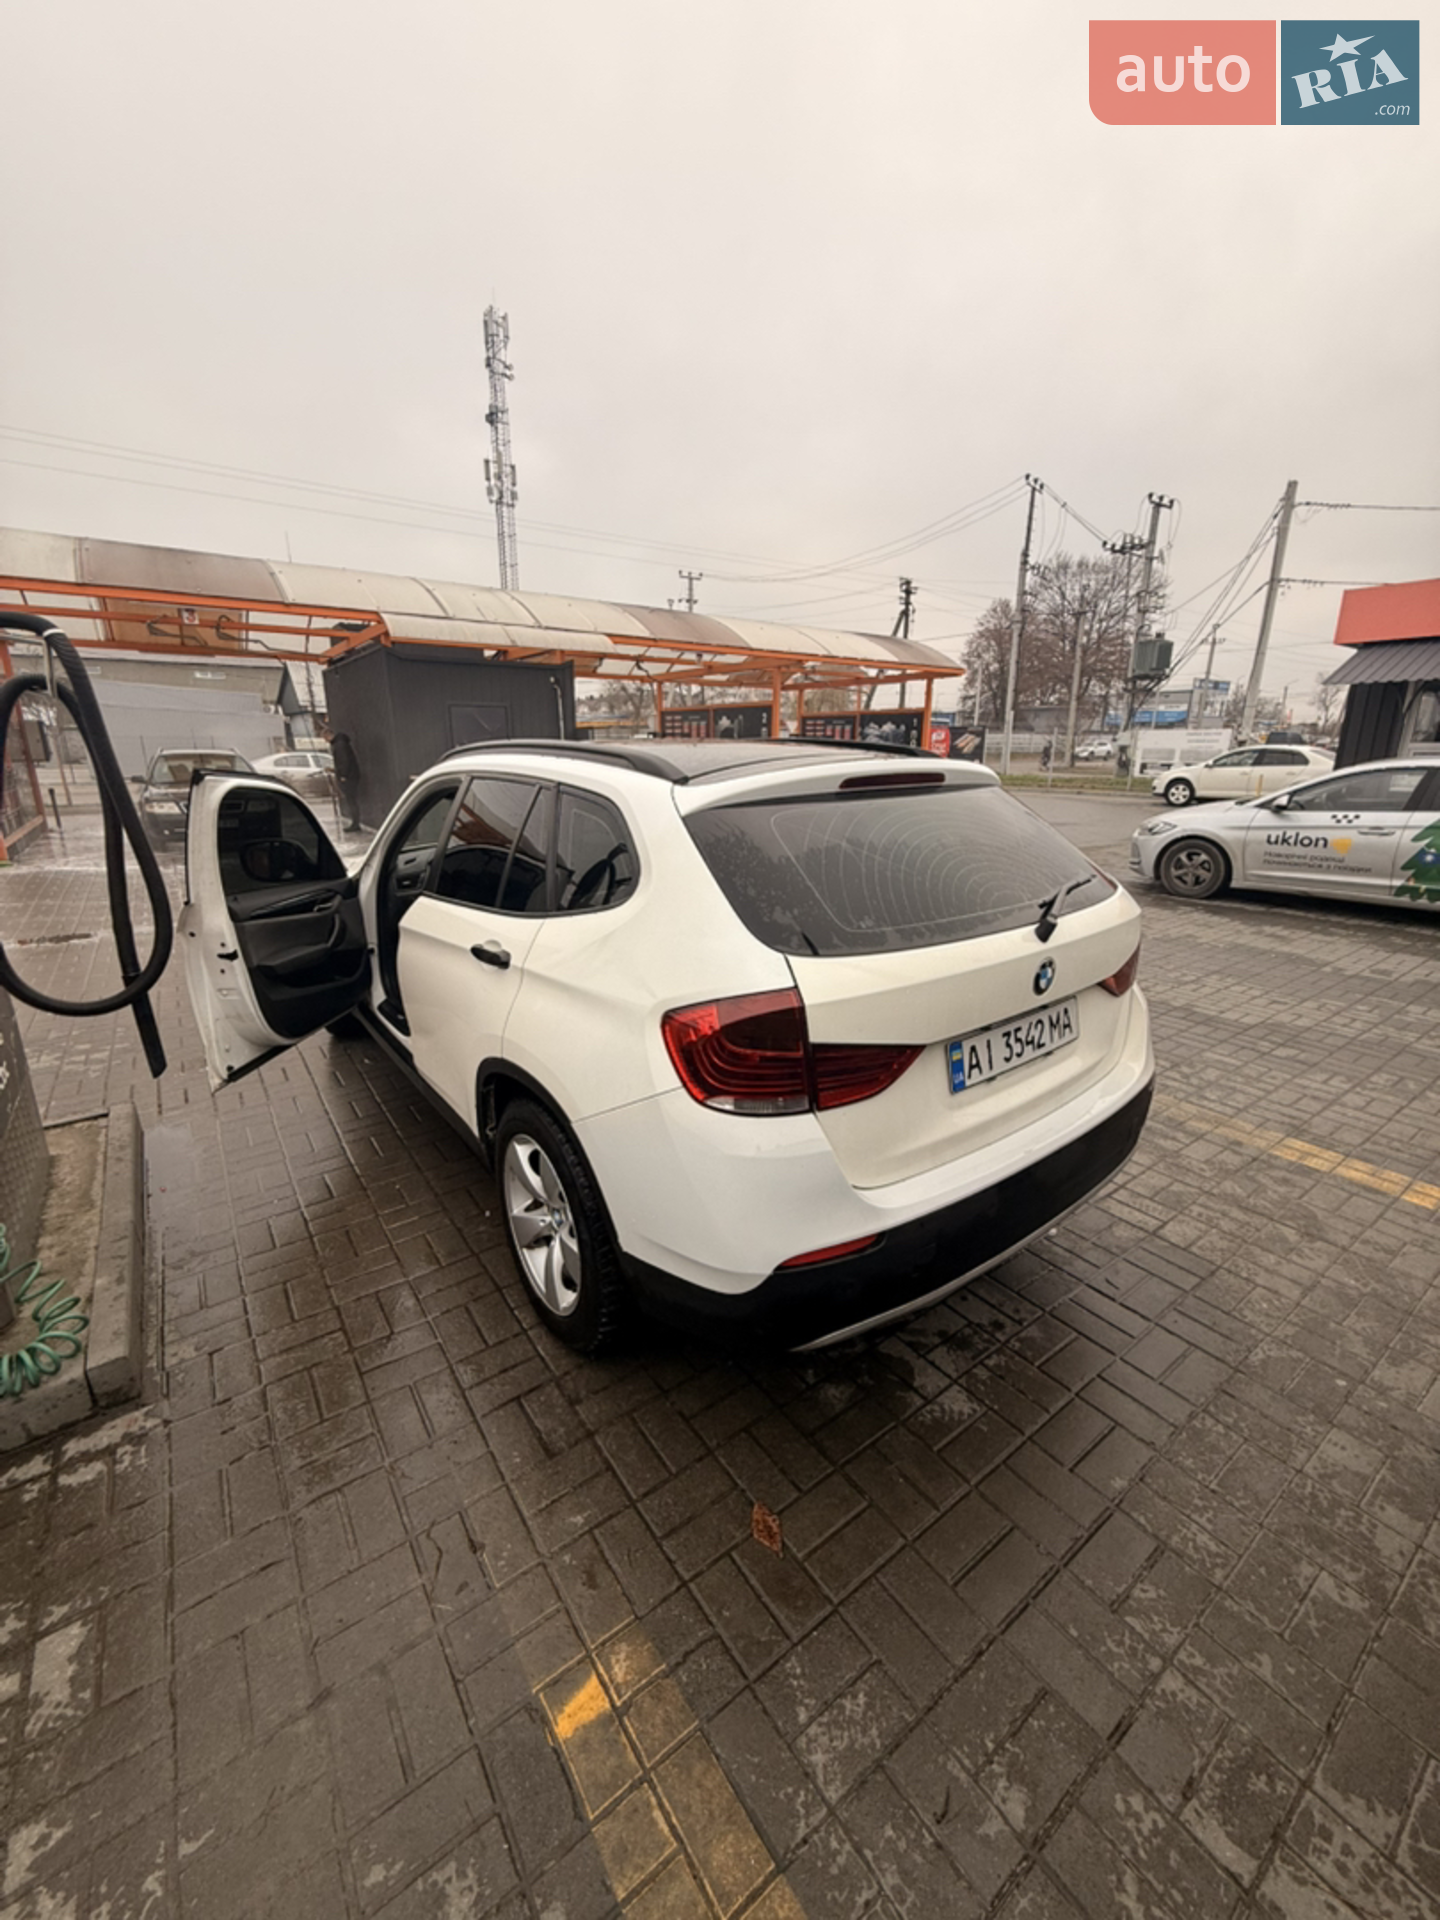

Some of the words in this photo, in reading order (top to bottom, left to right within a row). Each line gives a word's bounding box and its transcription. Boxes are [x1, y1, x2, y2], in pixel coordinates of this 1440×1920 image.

[1266, 831, 1329, 849] uklon
[967, 1038, 993, 1080] AI
[1002, 1019, 1046, 1063] 3542
[1048, 1007, 1073, 1043] MA
